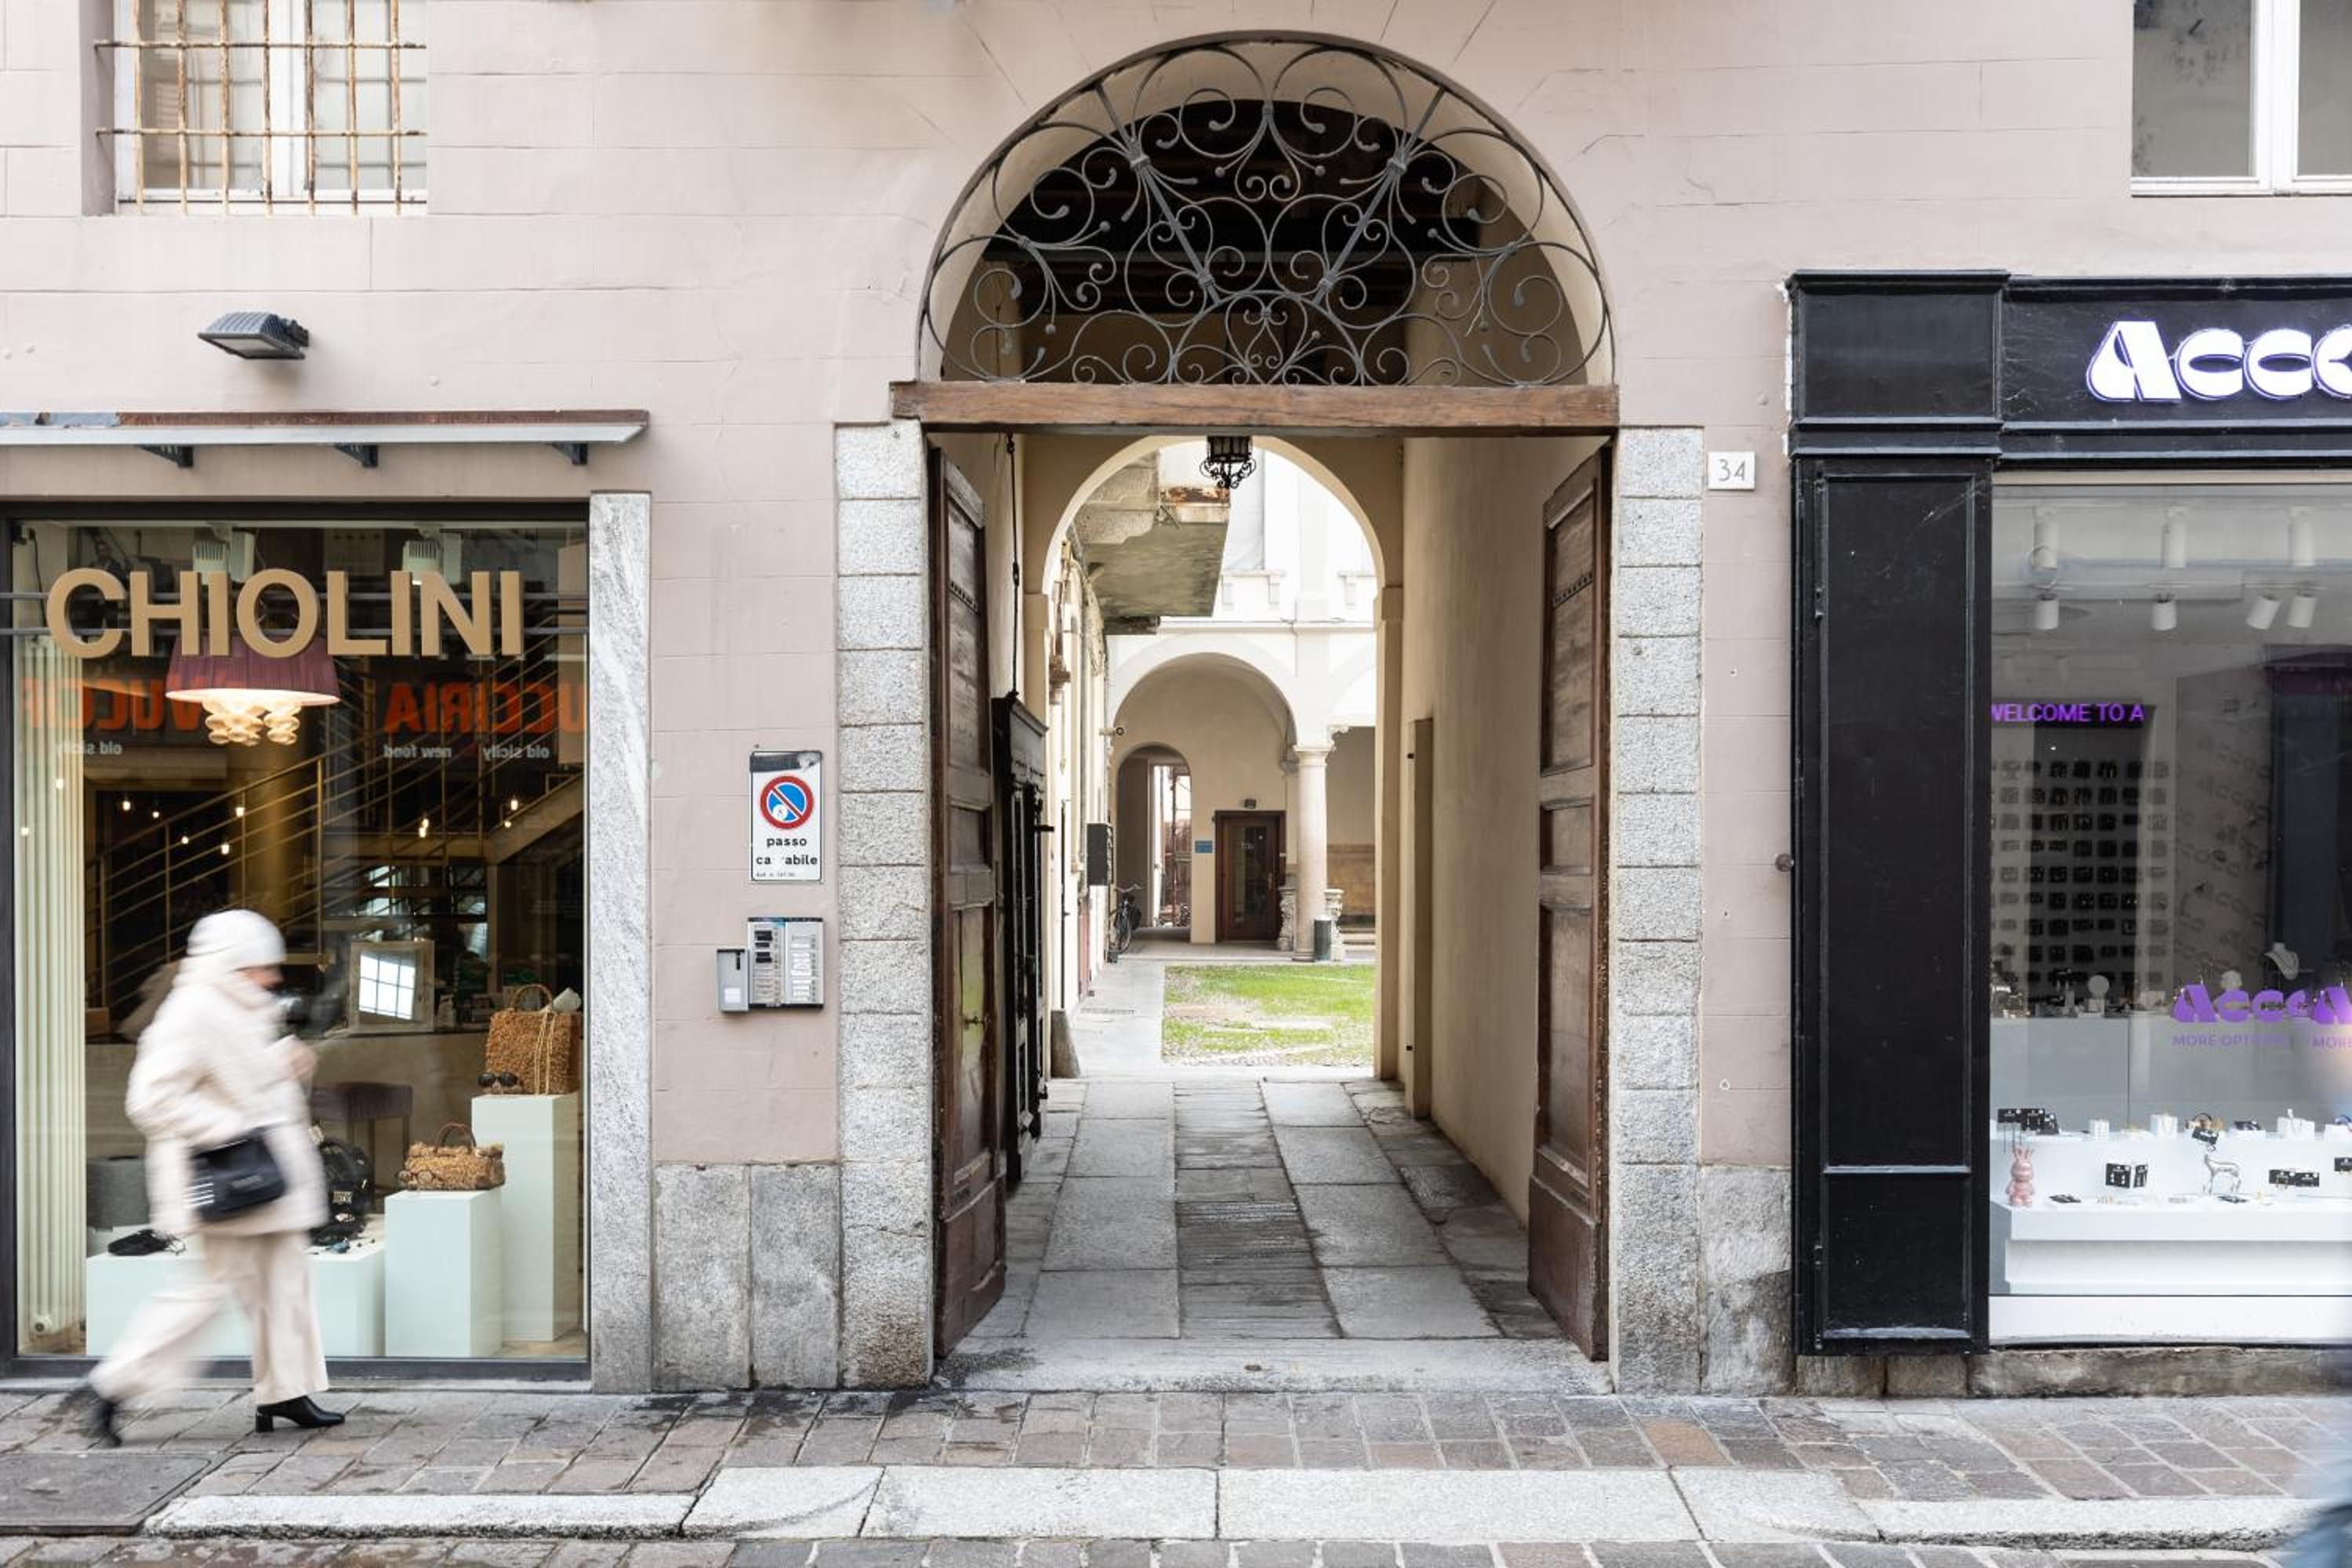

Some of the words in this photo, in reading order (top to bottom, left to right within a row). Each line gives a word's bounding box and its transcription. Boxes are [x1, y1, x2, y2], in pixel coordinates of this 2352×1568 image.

[1718, 458, 1746, 481] 34
[46, 567, 524, 659] CHIOLINI
[1991, 702, 2091, 722] WELCOME
[2094, 702, 2125, 722] TO
[2129, 702, 2145, 721] A
[766, 837, 808, 848] passo
[756, 854, 818, 865] caabile
